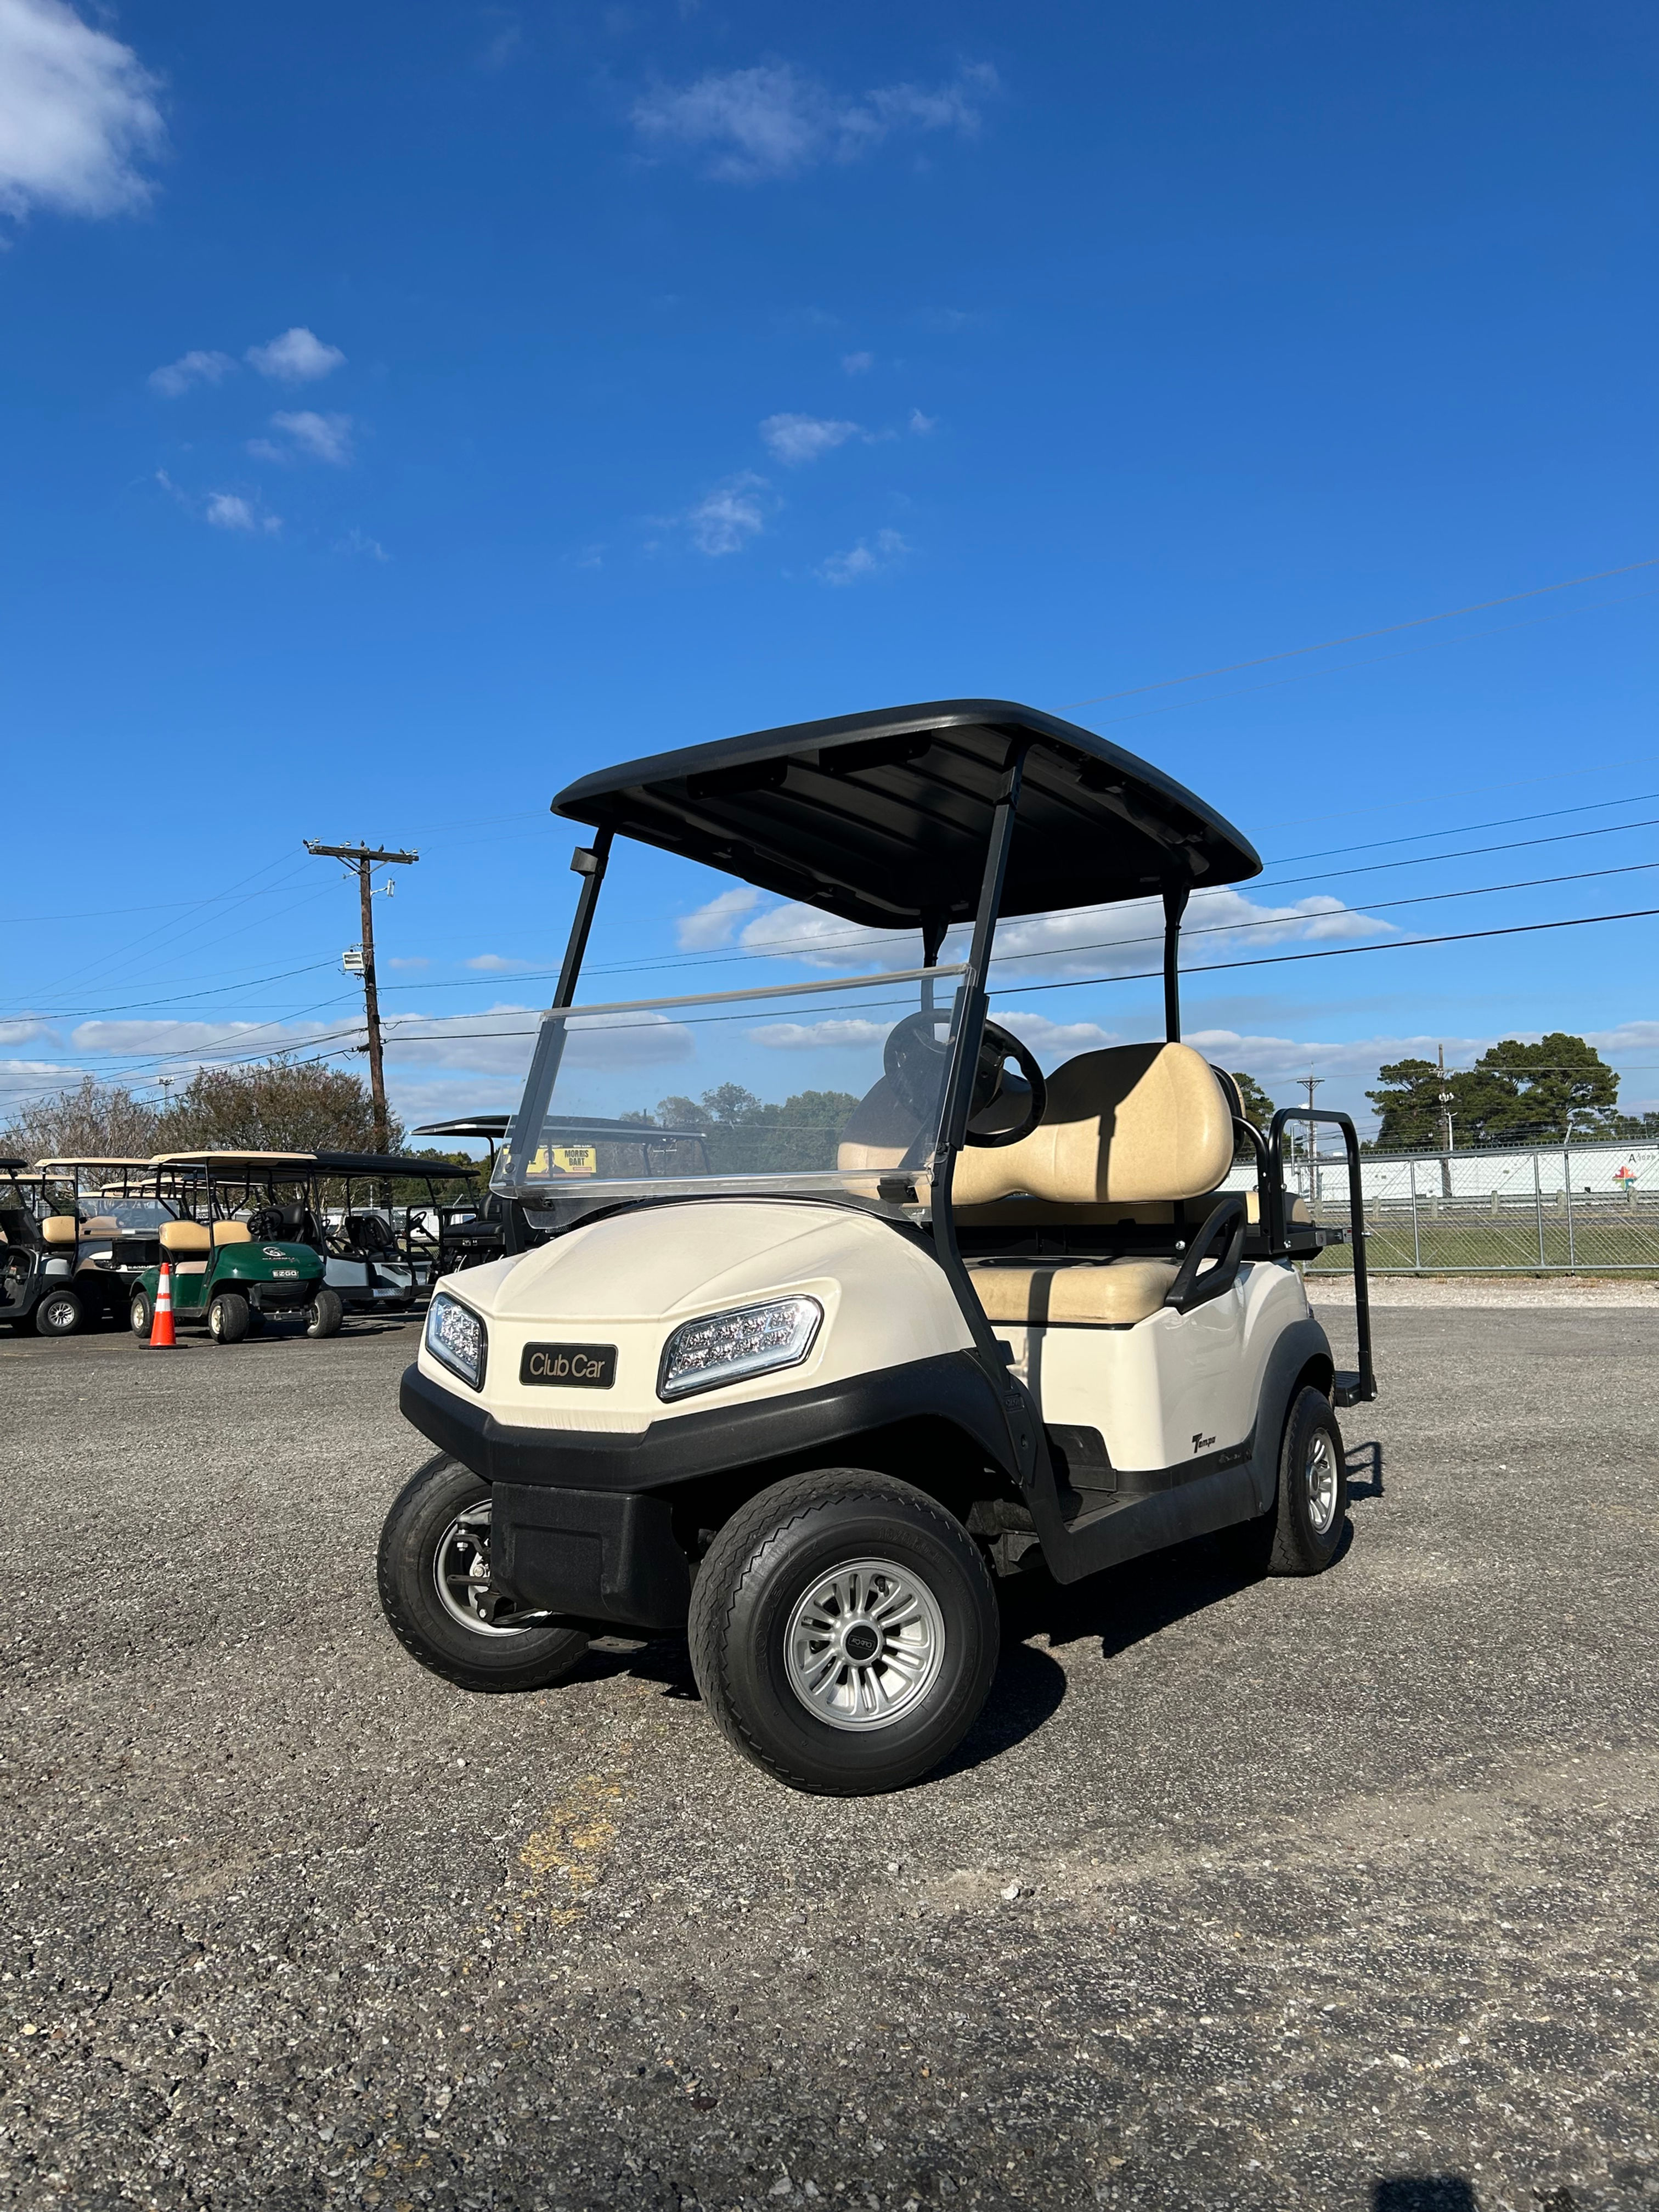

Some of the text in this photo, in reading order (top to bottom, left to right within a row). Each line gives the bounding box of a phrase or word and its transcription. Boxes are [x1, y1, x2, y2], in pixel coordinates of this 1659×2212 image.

[565, 1149, 589, 1158] MORRIS
[569, 1158, 585, 1166] BART
[529, 1352, 605, 1378] Club Car
[1192, 1432, 1216, 1453] Tempo
